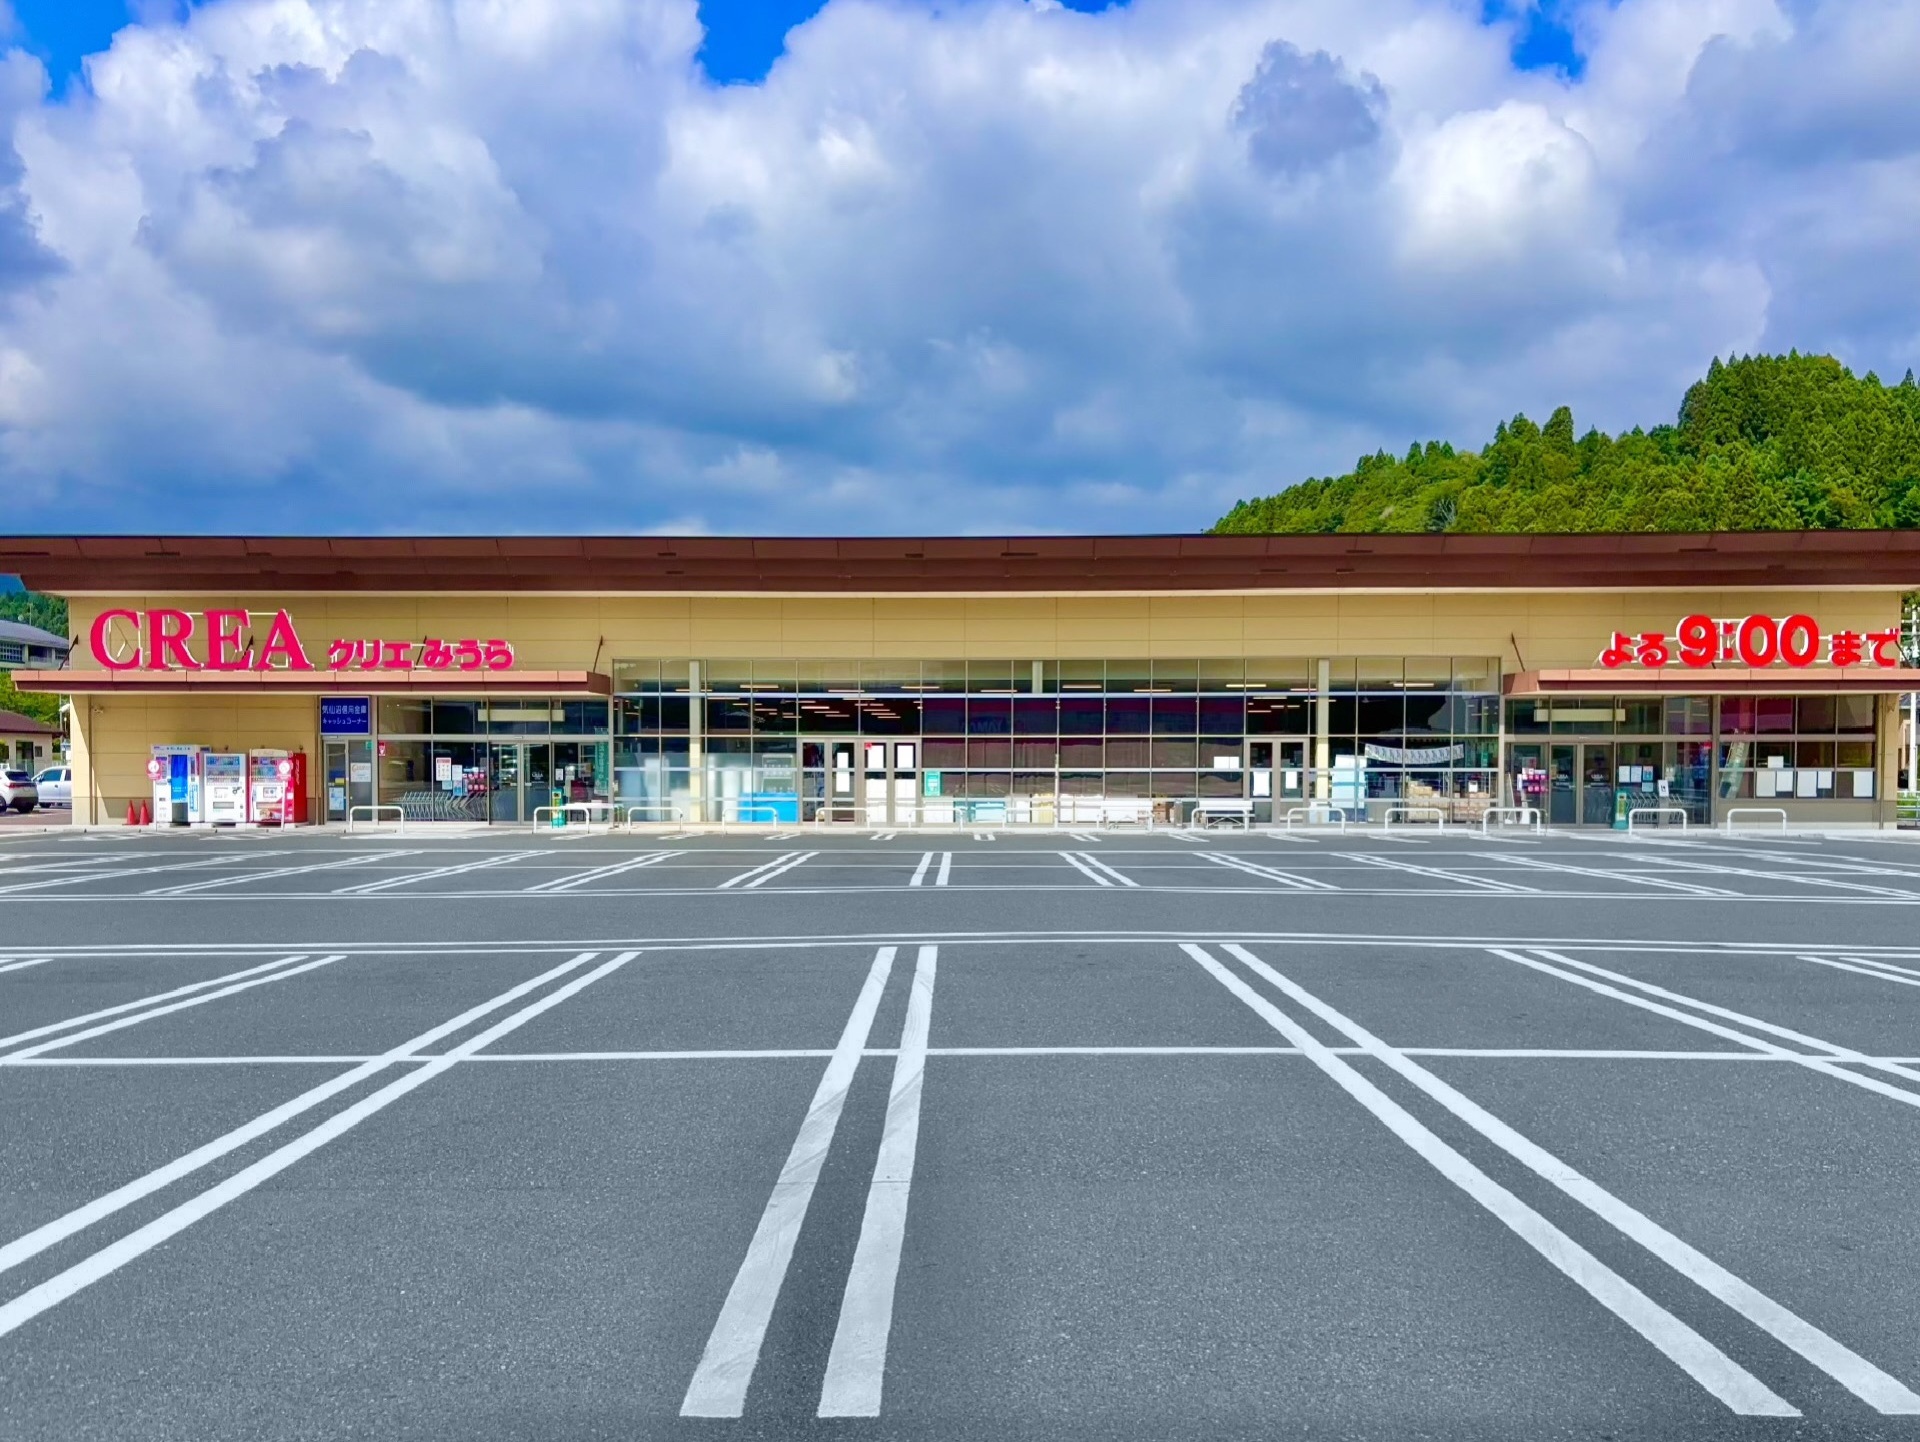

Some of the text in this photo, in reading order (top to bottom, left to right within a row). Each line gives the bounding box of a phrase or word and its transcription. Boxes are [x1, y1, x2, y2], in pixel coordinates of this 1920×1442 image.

[90, 608, 314, 670] CREA
[322, 717, 367, 725] キャッシュコーナー
